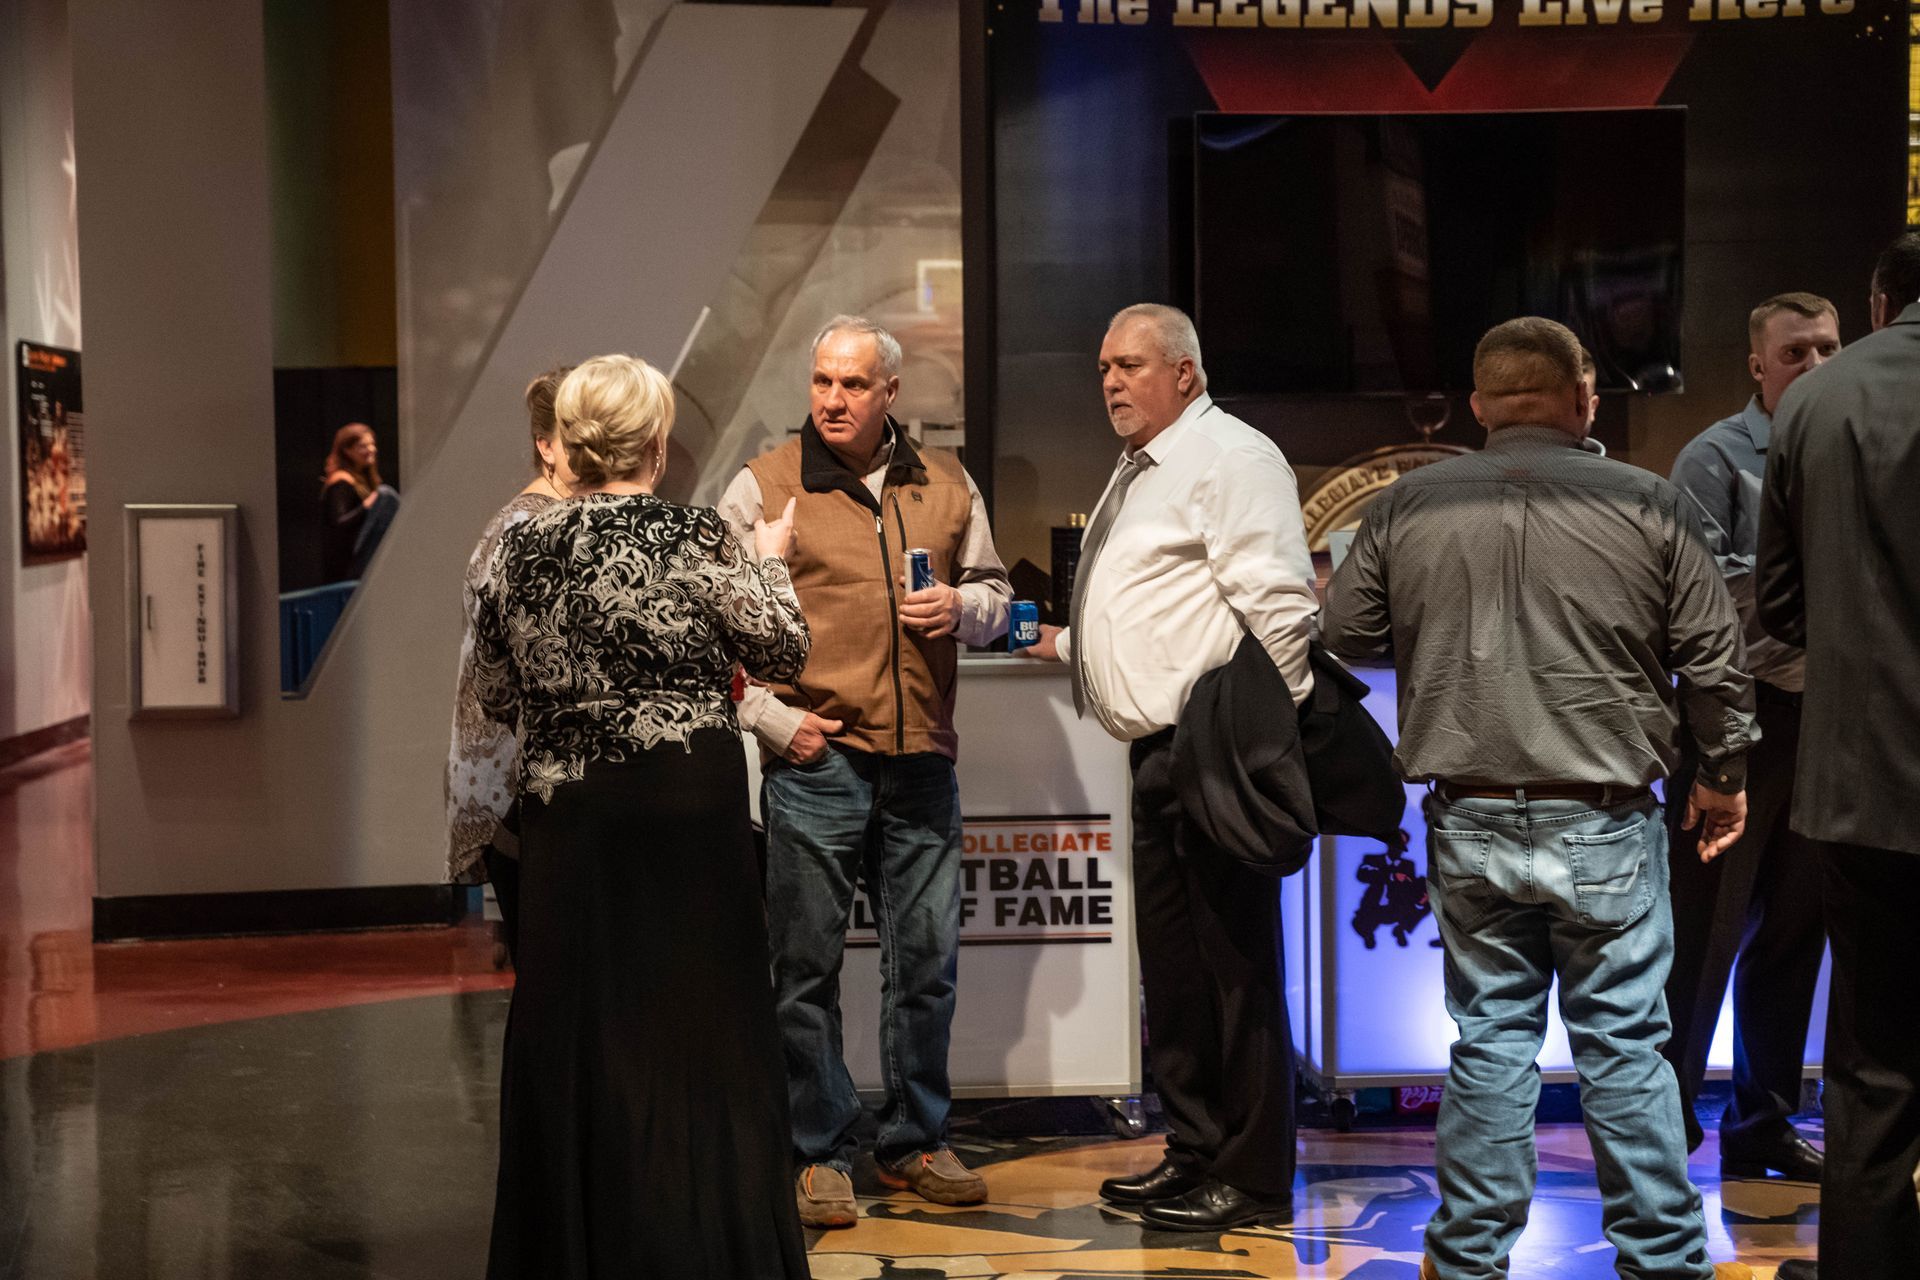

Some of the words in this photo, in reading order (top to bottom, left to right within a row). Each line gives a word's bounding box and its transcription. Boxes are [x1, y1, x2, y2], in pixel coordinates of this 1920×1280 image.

[962, 833, 1112, 854] OLLEGIATE
[960, 857, 1112, 892] TBALL
[959, 897, 978, 927] F
[995, 895, 1113, 928] FAME
